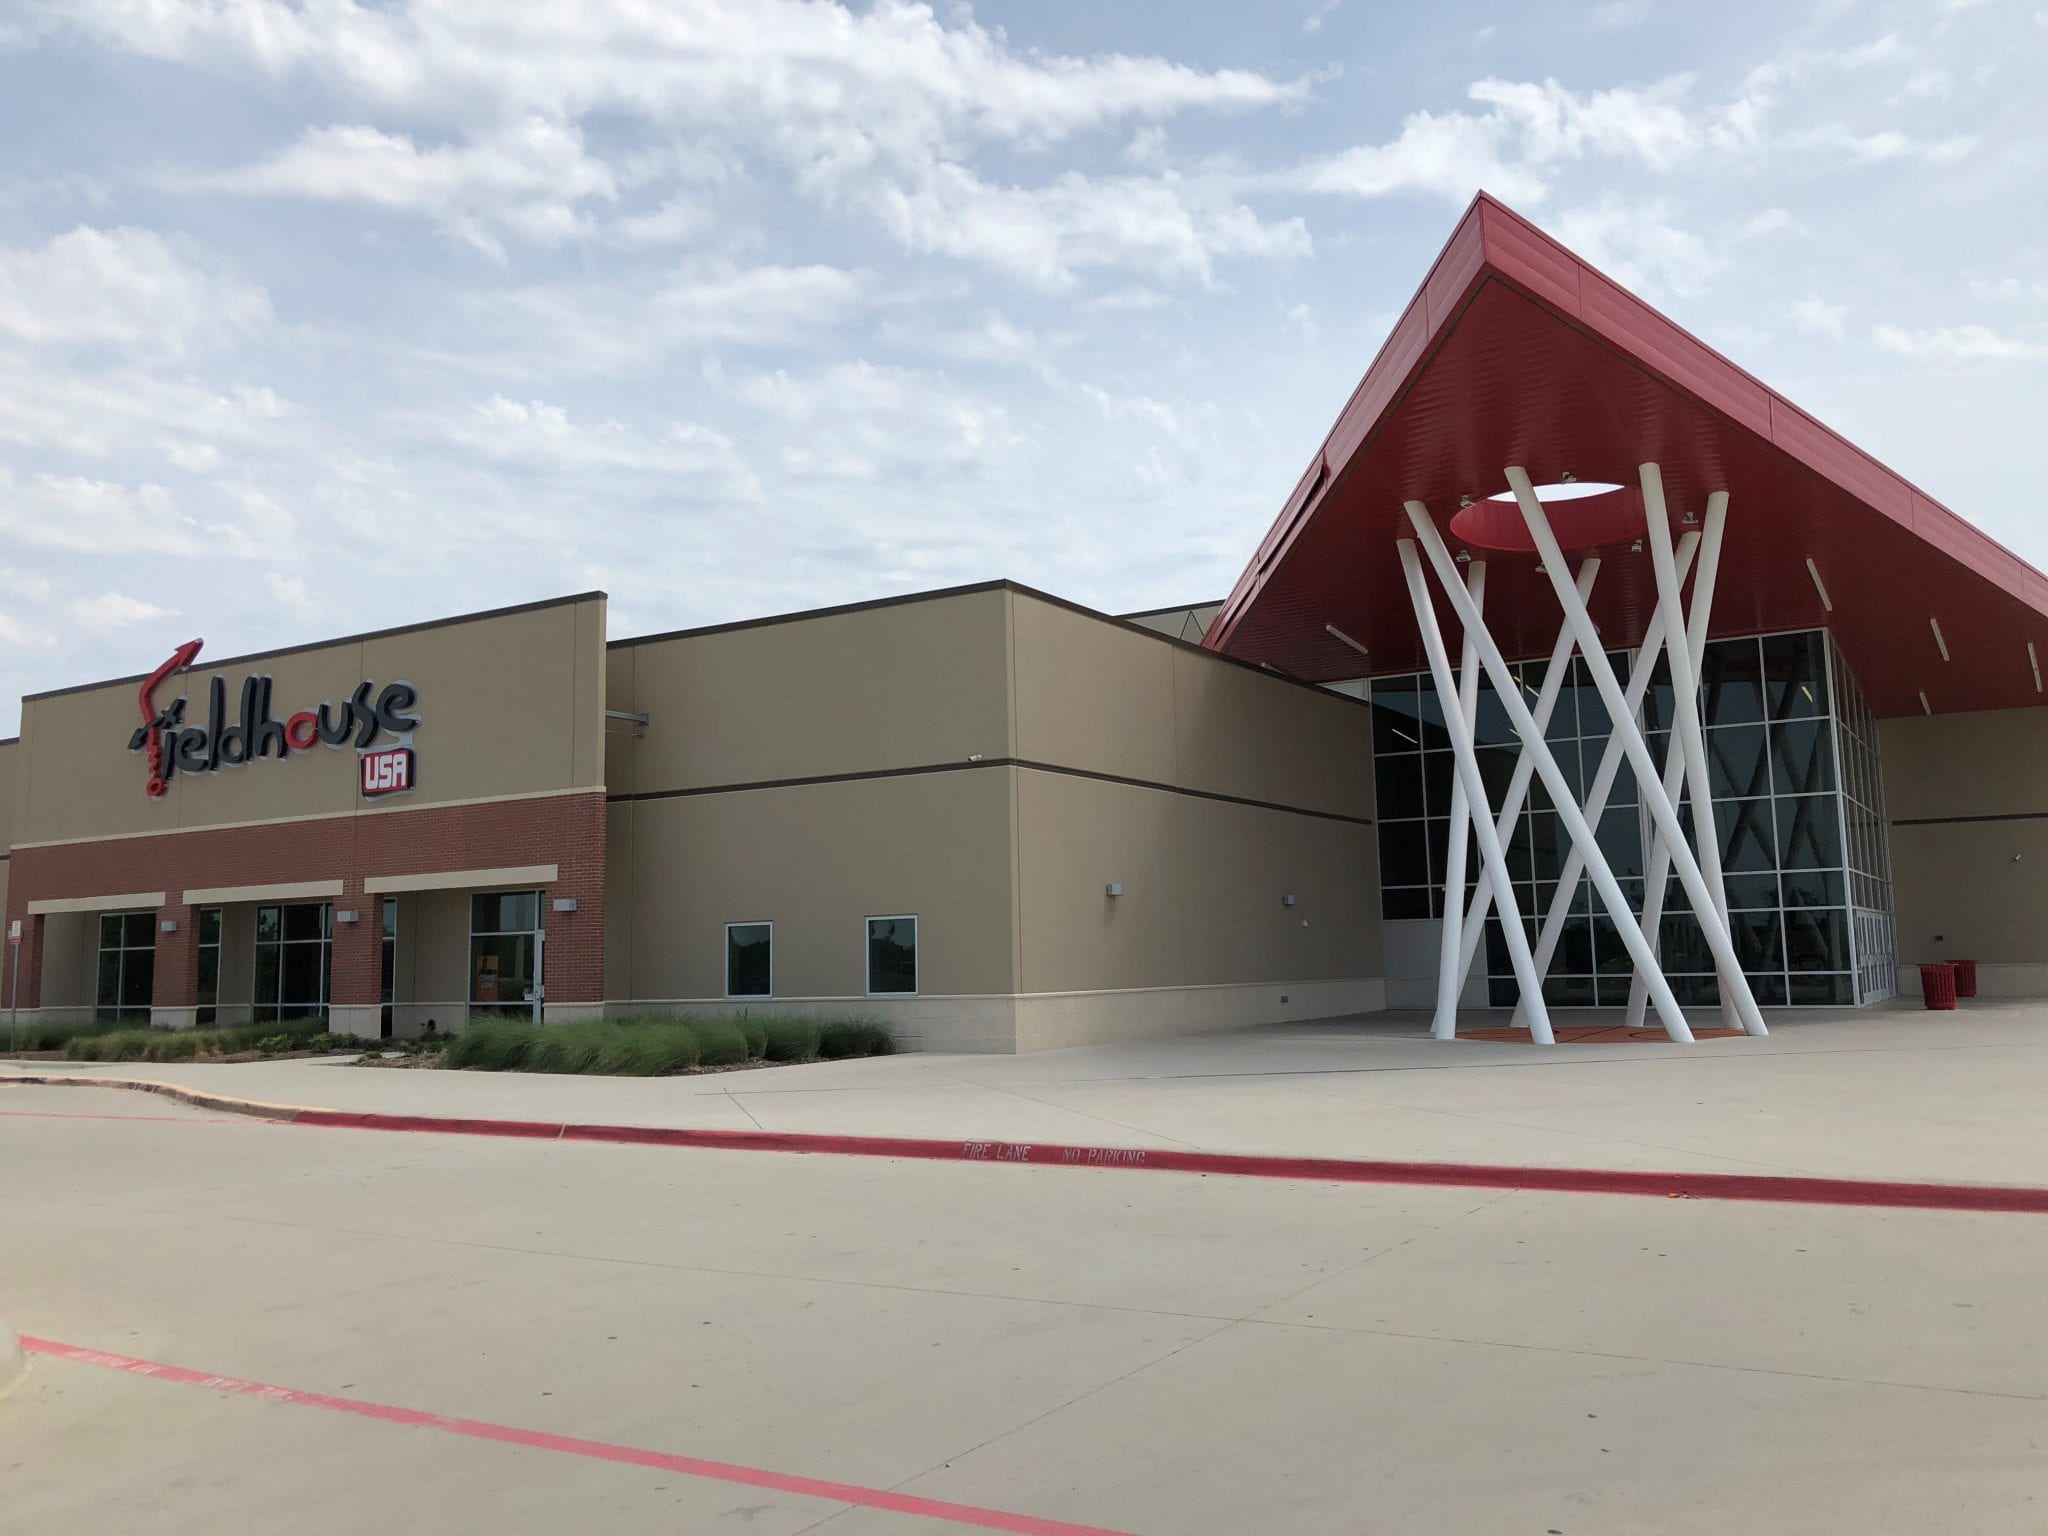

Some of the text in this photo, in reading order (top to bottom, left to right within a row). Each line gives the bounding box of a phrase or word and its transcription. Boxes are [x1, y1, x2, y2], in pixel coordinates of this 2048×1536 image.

[365, 752, 408, 791] USA
[962, 1143, 1146, 1165] FIRE LANE NO PARKING
